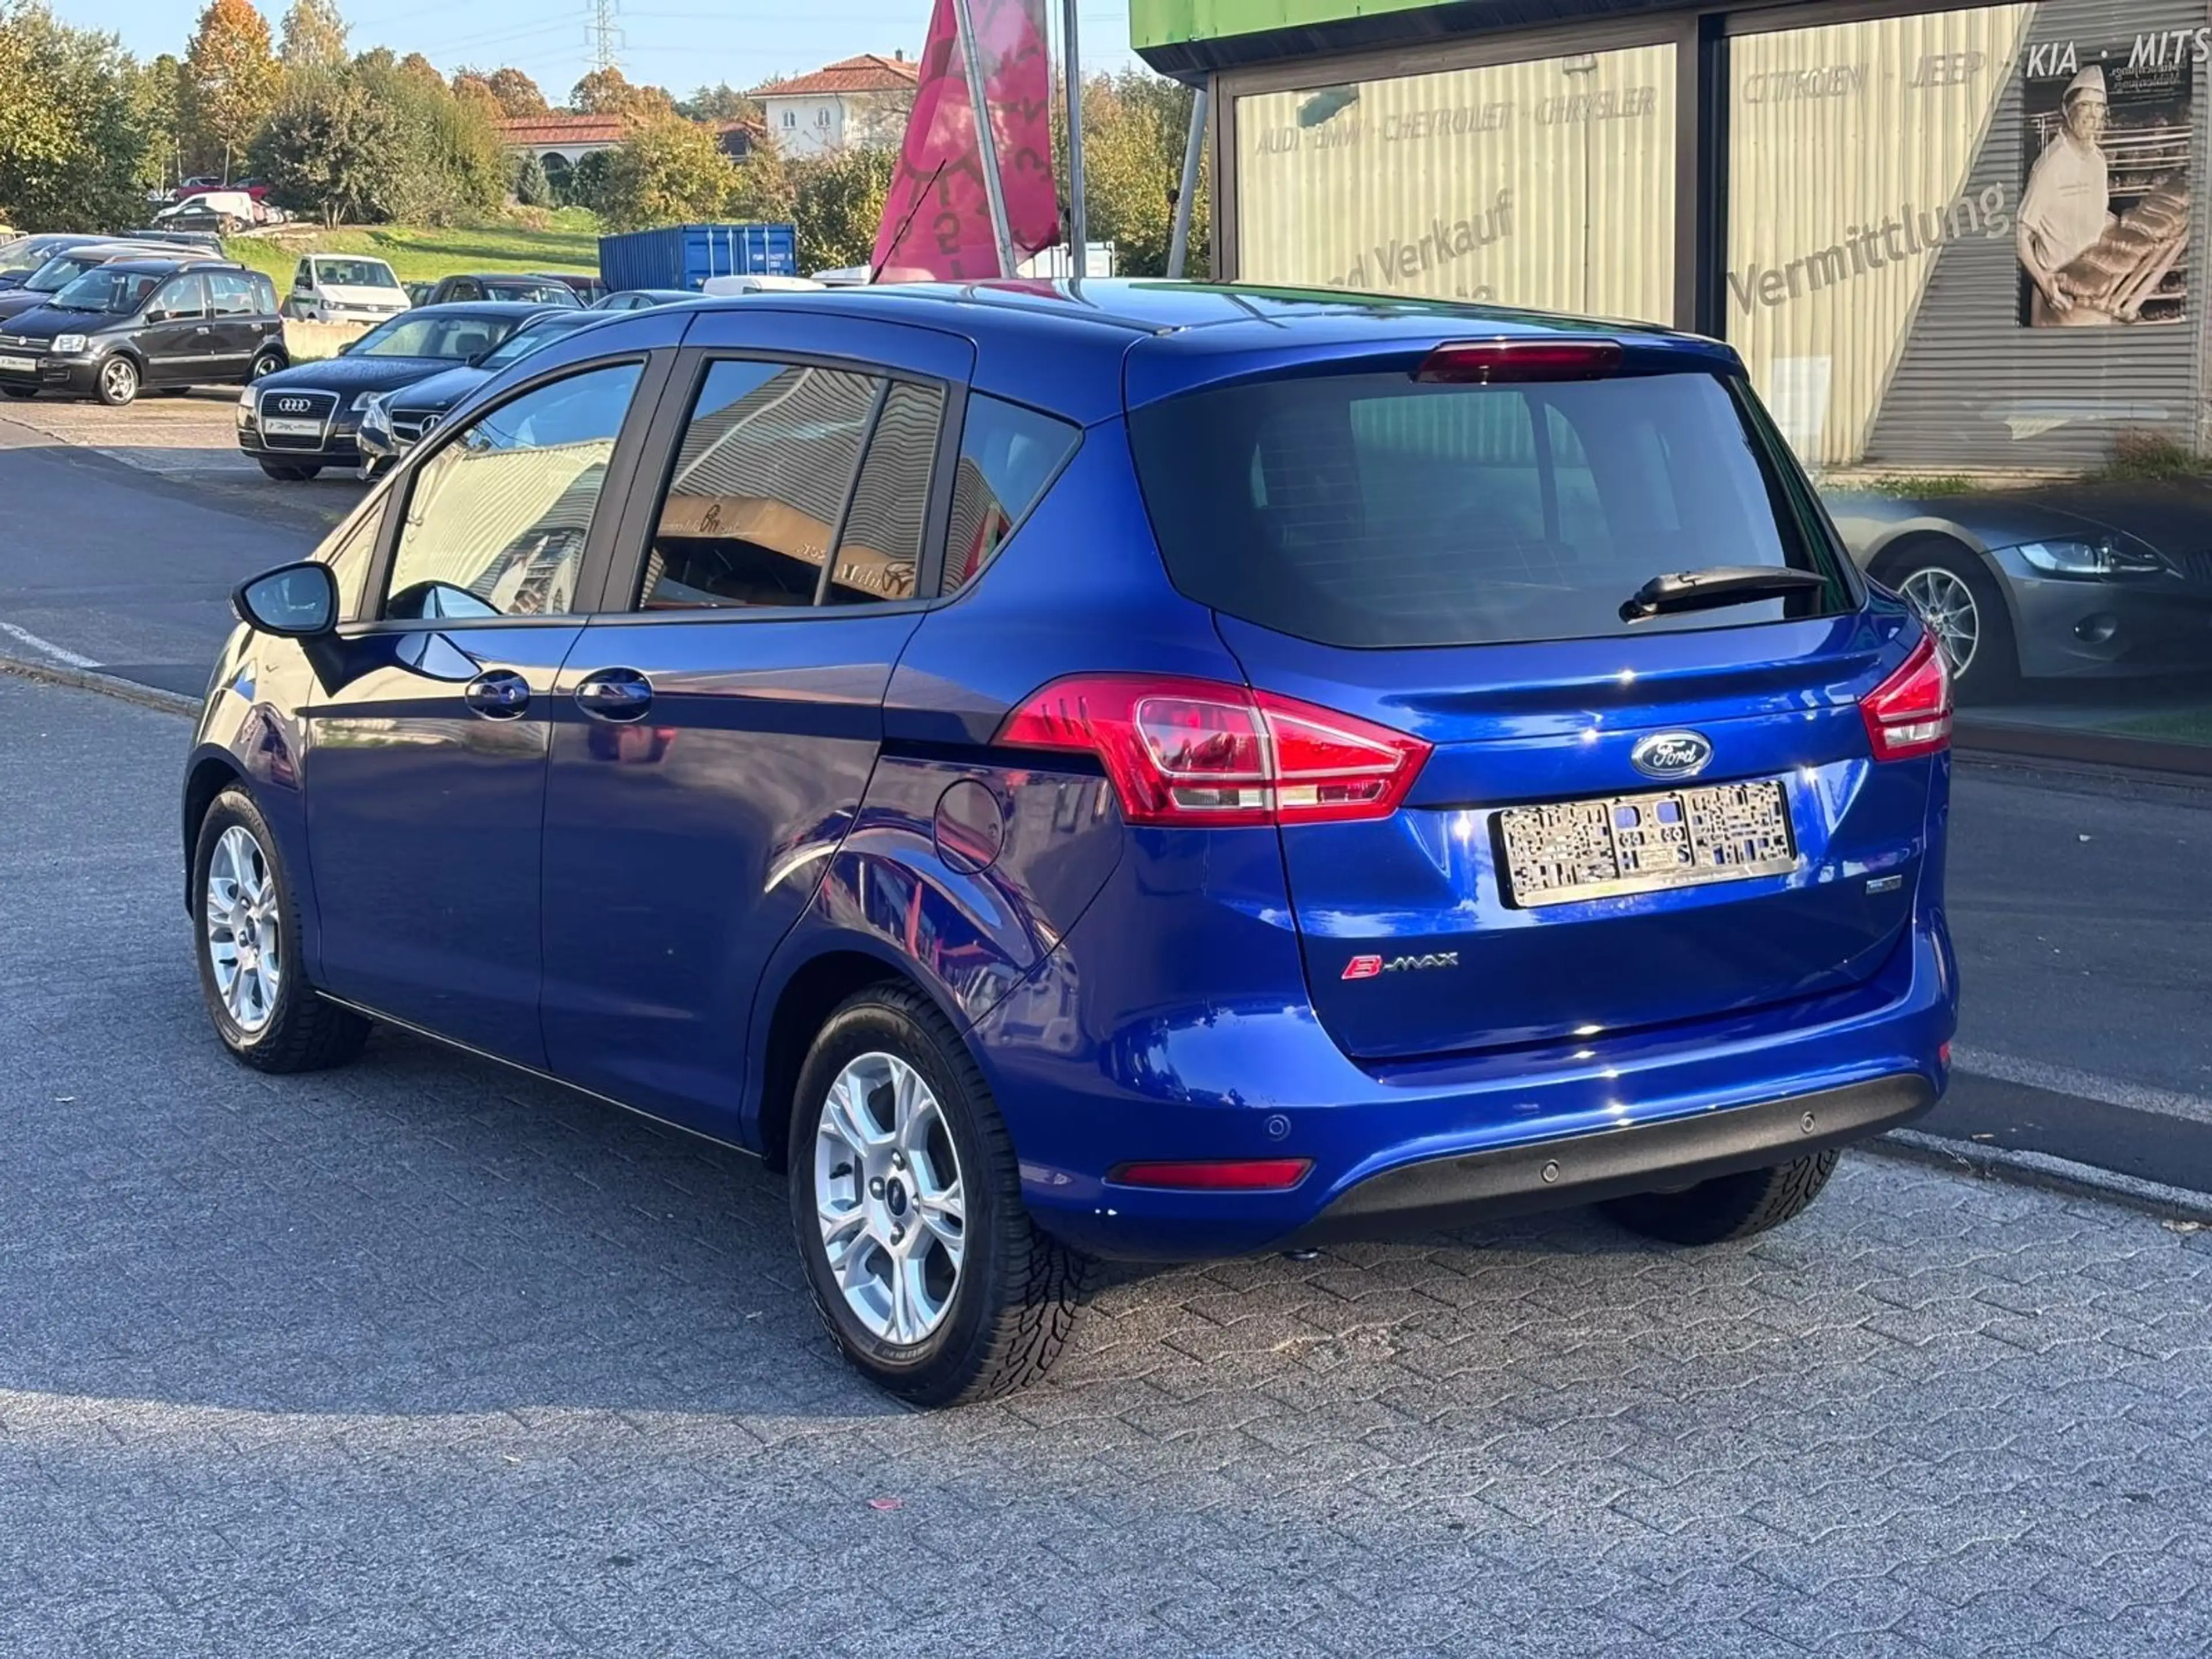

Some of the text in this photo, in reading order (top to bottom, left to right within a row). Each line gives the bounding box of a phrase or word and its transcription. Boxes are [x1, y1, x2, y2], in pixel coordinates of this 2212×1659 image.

[1908, 51, 1986, 89] JEEP
[2027, 40, 2078, 78] KIA
[1256, 126, 1300, 156] AUDI
[1384, 101, 1514, 142] CHEVROLET
[1536, 86, 1657, 126] CHRYSLER
[1374, 188, 1513, 286] Verkauf
[1728, 181, 2010, 316] Vermittlung
[1653, 740, 1697, 767] Ford
[1341, 952, 1459, 980] B-MAX
